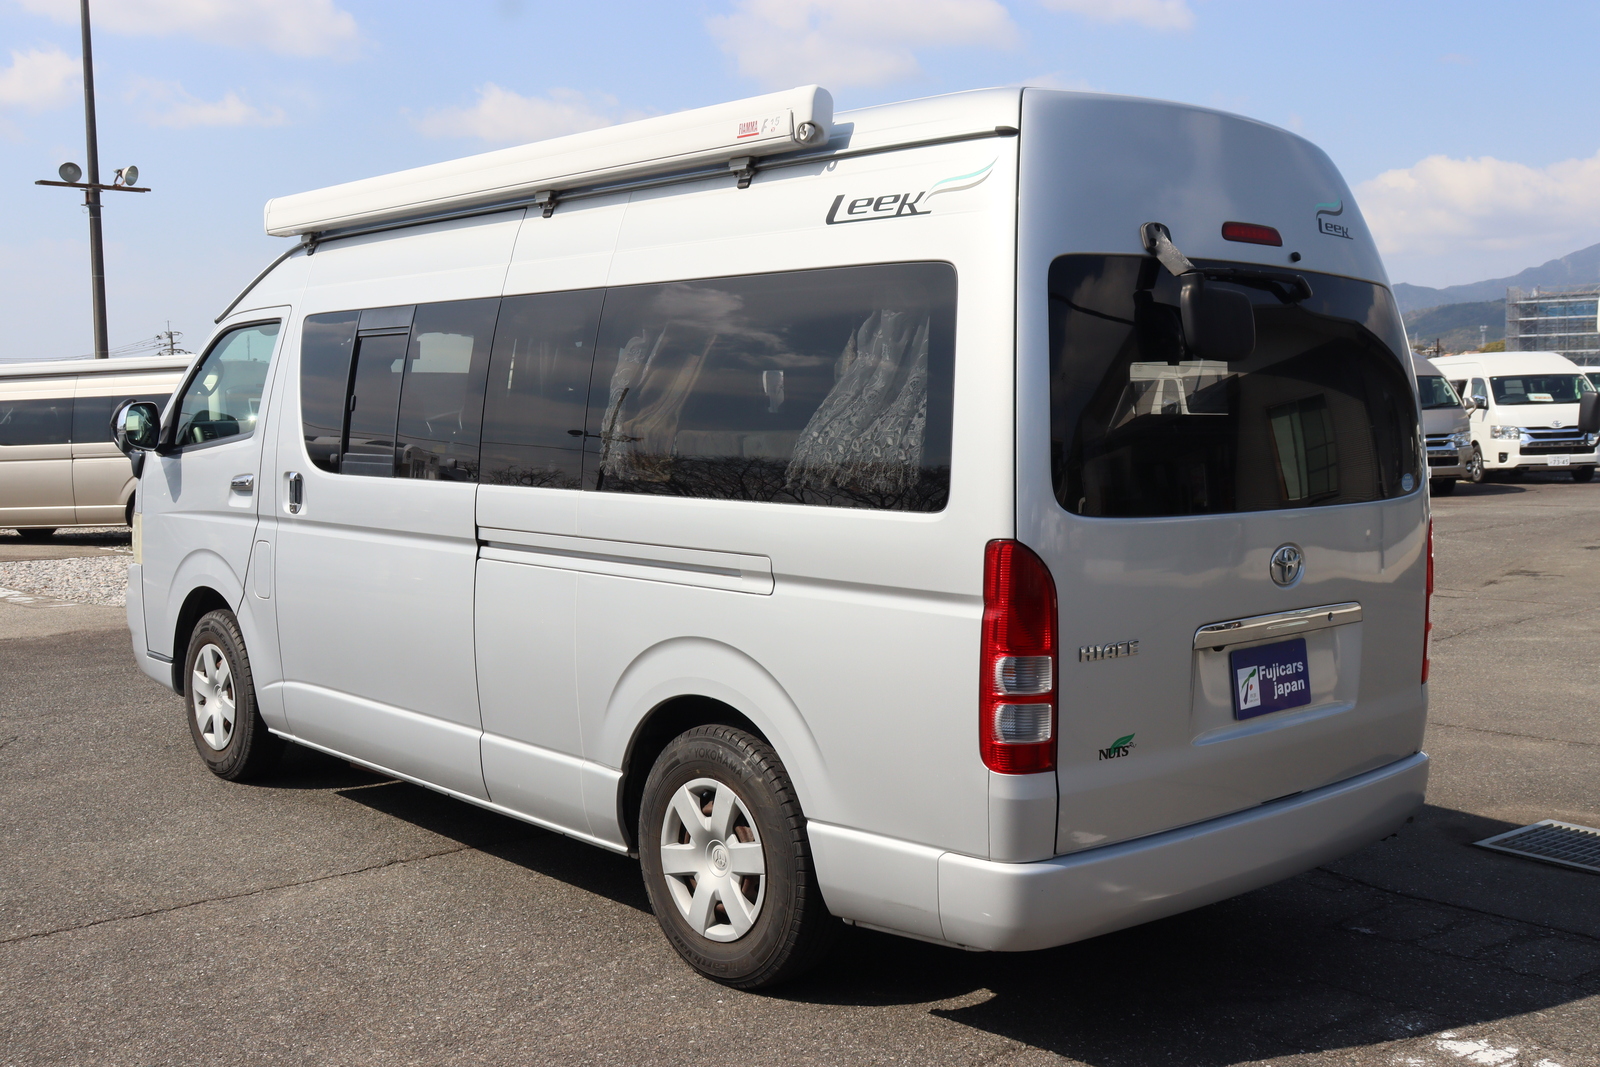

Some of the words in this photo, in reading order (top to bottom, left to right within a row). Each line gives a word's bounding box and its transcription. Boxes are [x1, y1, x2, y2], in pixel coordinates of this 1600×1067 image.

[825, 191, 932, 225] Leek
[1318, 218, 1353, 240] Leek
[1079, 639, 1139, 663] HIACE
[1259, 661, 1304, 681] Fujicars
[1273, 679, 1305, 699] japan
[694, 747, 744, 779] YOKOHAMA
[1099, 745, 1130, 761] NUTS
